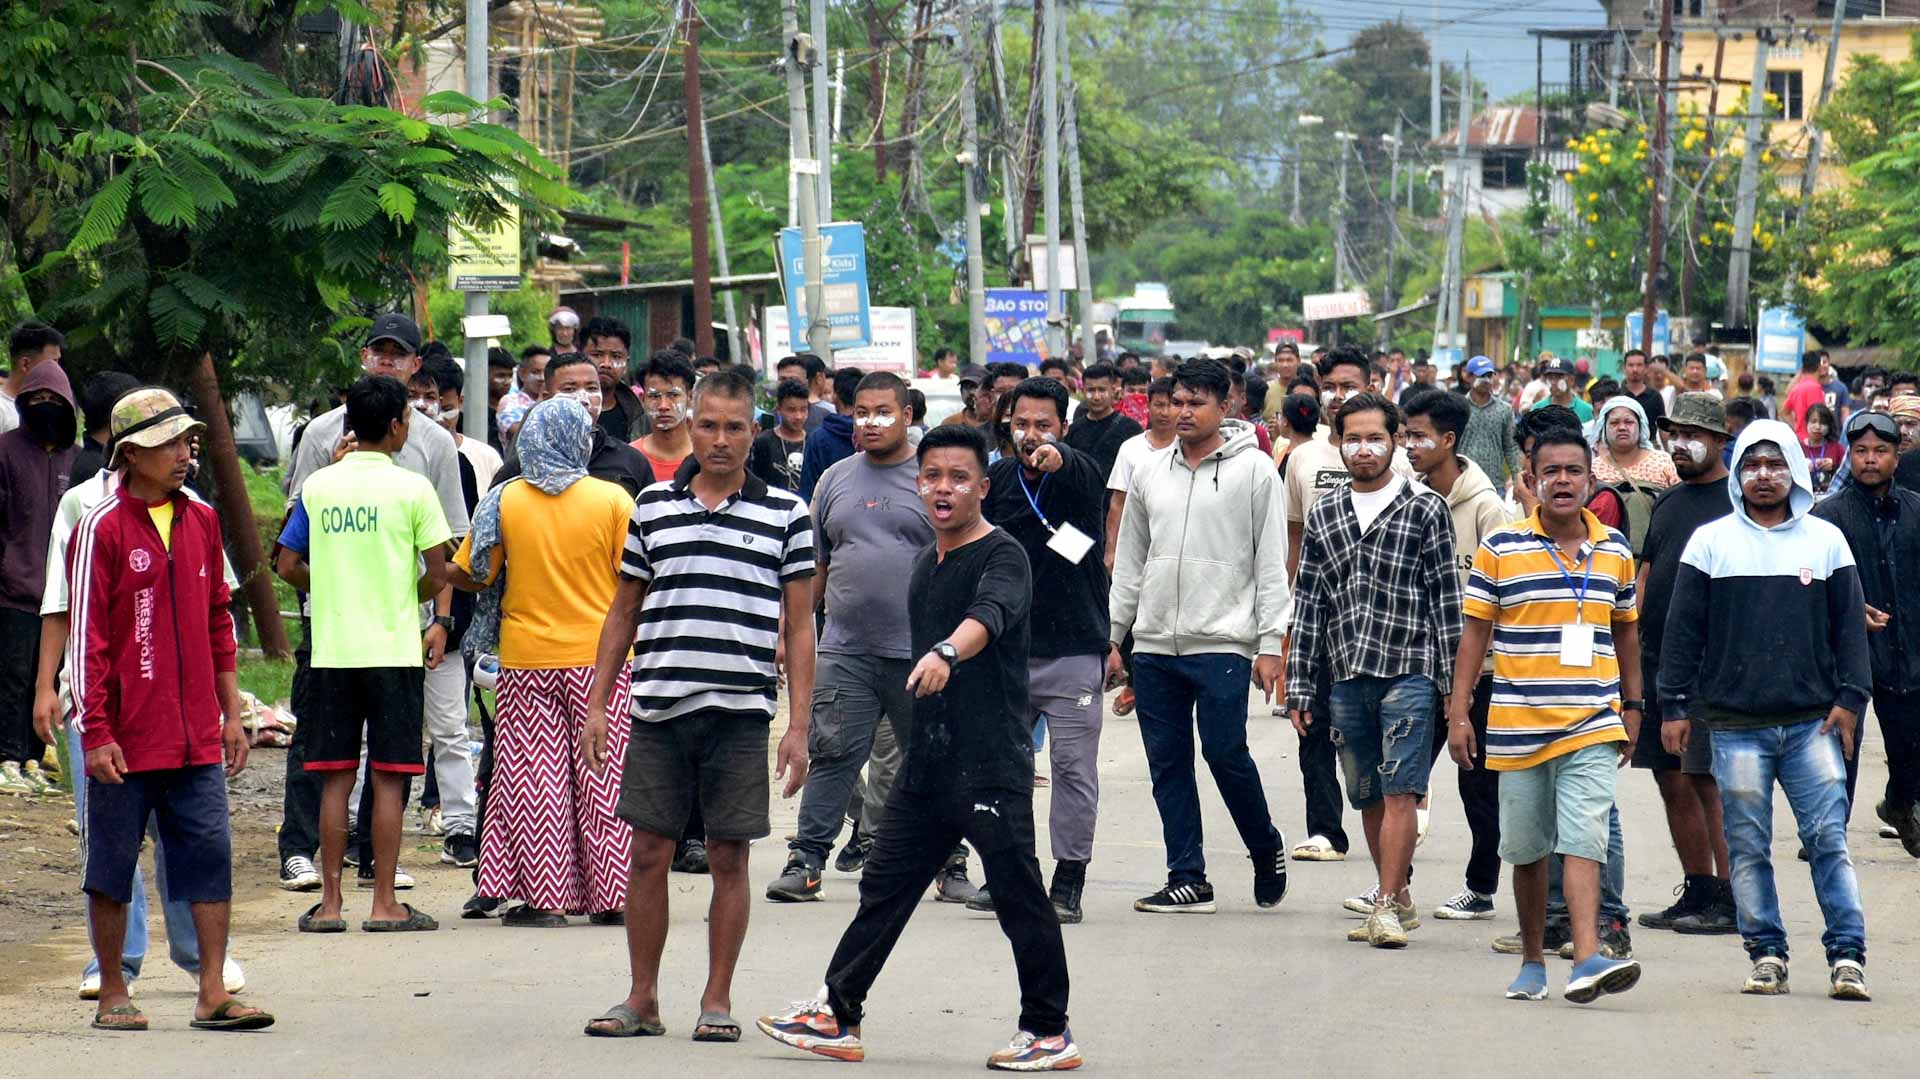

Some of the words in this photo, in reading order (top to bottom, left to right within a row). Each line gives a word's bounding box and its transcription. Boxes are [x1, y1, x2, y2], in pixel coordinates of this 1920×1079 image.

[832, 258, 852, 268] Kids
[321, 506, 378, 534] COACH
[1456, 554, 1473, 570] LS
[139, 588, 154, 680] PRESHYOJIT
